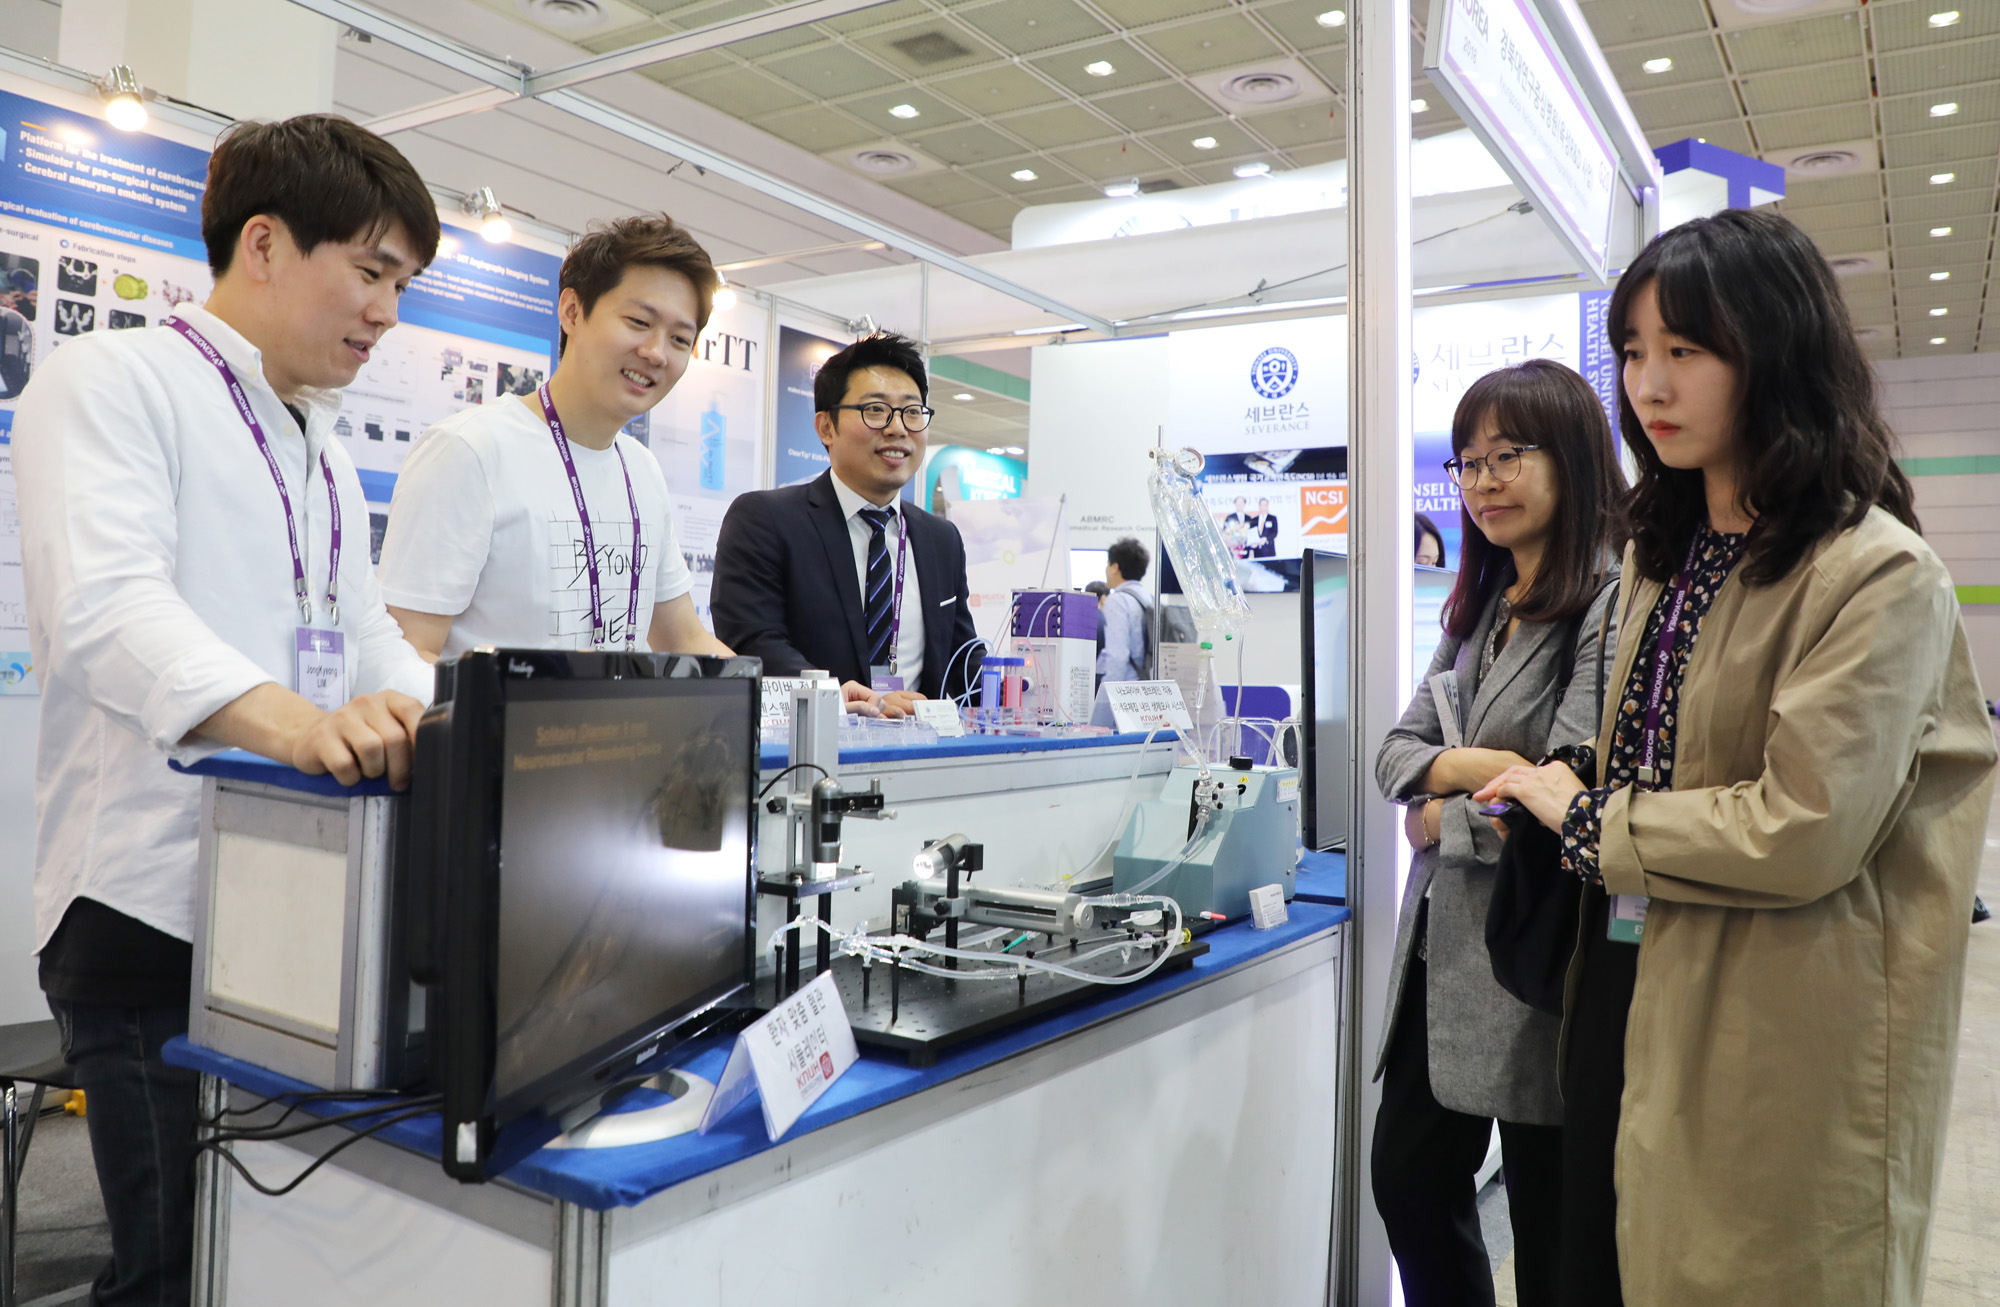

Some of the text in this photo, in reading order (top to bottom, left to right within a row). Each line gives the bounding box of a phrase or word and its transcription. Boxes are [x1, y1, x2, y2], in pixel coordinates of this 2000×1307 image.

[1460, 0, 1488, 43] OREA
[20, 130, 207, 191] Platform for the treatment of cerebrovas
[25, 147, 196, 202] Simulator for pre-surgical evaluation
[24, 162, 188, 213] Cerebral aneurysm embolic system
[0, 200, 24, 212] rgical
[25, 206, 68, 224] evaluation
[69, 217, 79, 225] of
[0, 227, 39, 241] e-surgical
[1586, 298, 1599, 367] HEALTH
[694, 331, 758, 372] rTT
[1431, 333, 1567, 371] 세브란스
[231, 382, 248, 411] KOREA
[1244, 402, 1310, 423] 세브란스
[1600, 363, 1613, 427] UNIVE
[1245, 420, 1310, 435] SEVERANCE
[555, 429, 570, 462] HONOREM
[571, 476, 584, 512] BIO KOREA
[1304, 490, 1343, 506] NCSI
[1413, 482, 1445, 497] NSEI
[1415, 499, 1462, 512] EALTH
[1080, 515, 1115, 523] ABMRC
[585, 535, 594, 569] HONOREM
[1666, 590, 1685, 633] BIO KOREA
[761, 680, 793, 696] 파이버
[1651, 664, 1665, 710] HONOREM
[1171, 700, 1187, 711] 시스템
[1644, 729, 1655, 768] BIO KOR
[767, 1012, 789, 1047] 환자
[787, 1023, 829, 1073] 시뮬레이터
